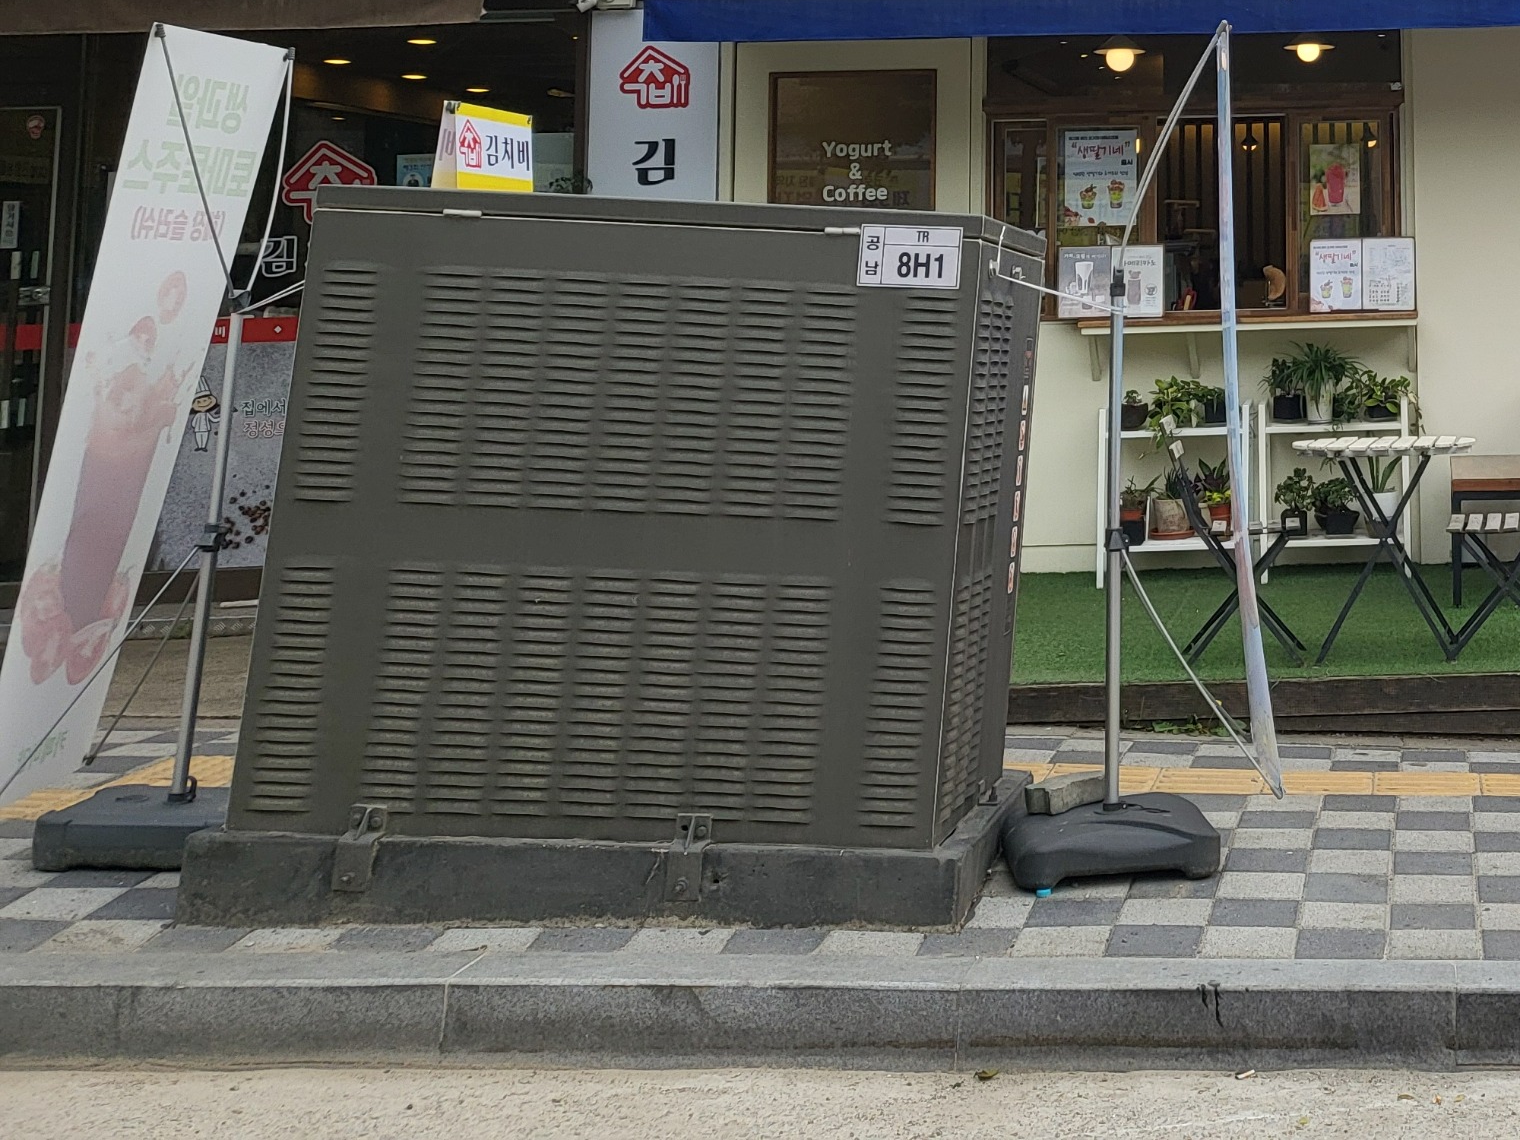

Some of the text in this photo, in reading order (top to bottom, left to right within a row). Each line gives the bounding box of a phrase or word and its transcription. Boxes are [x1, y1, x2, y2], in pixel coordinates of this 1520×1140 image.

[485, 135, 530, 171] 김치비
[822, 139, 892, 161] Yogurt
[632, 138, 676, 186] 김
[822, 183, 888, 203] Coffee
[916, 231, 929, 242] TR
[897, 252, 944, 279] 8H1
[240, 398, 286, 416] 집에서
